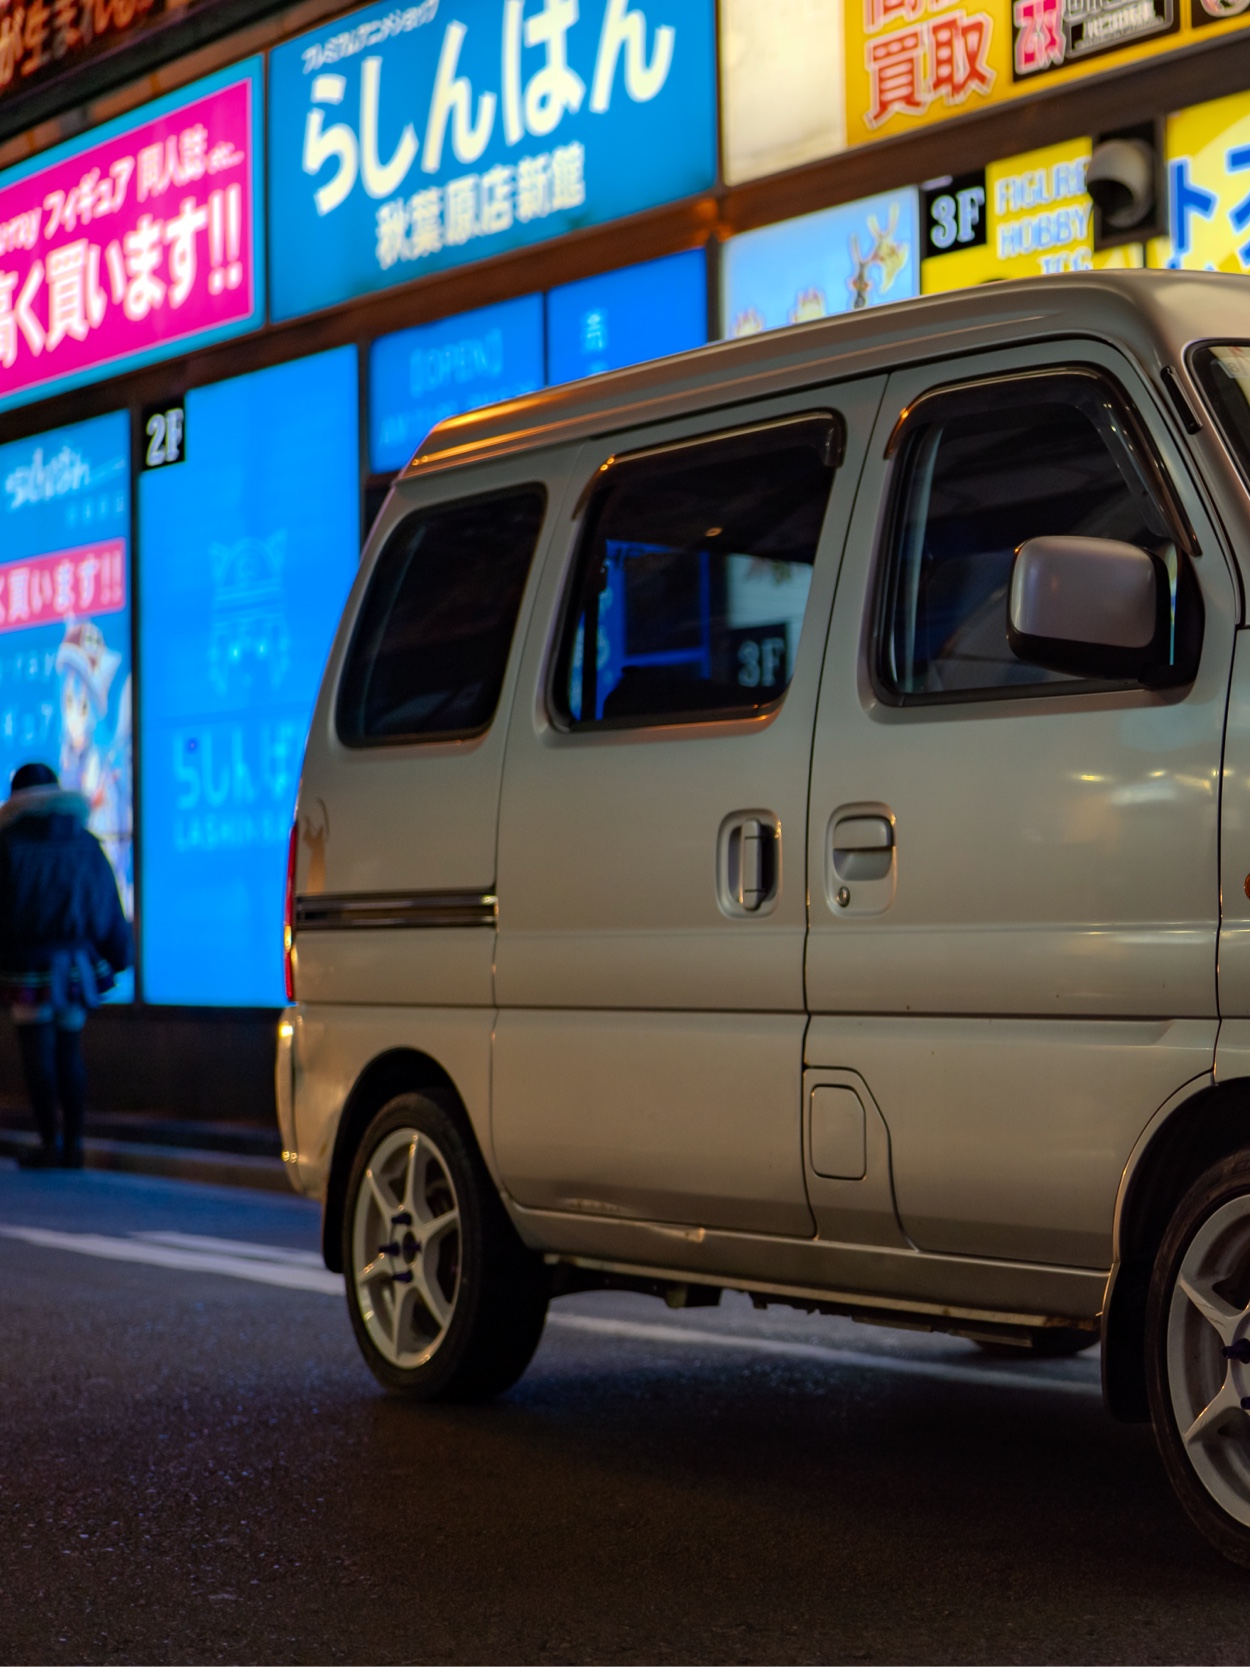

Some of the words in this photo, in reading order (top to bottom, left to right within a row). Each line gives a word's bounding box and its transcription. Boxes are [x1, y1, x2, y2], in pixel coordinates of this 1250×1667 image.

[302, 0, 676, 216] らしんばん
[864, 10, 996, 130] 買取
[374, 140, 586, 270] 秋葉原店新館
[930, 186, 987, 249] 3F
[145, 408, 185, 467] 2F
